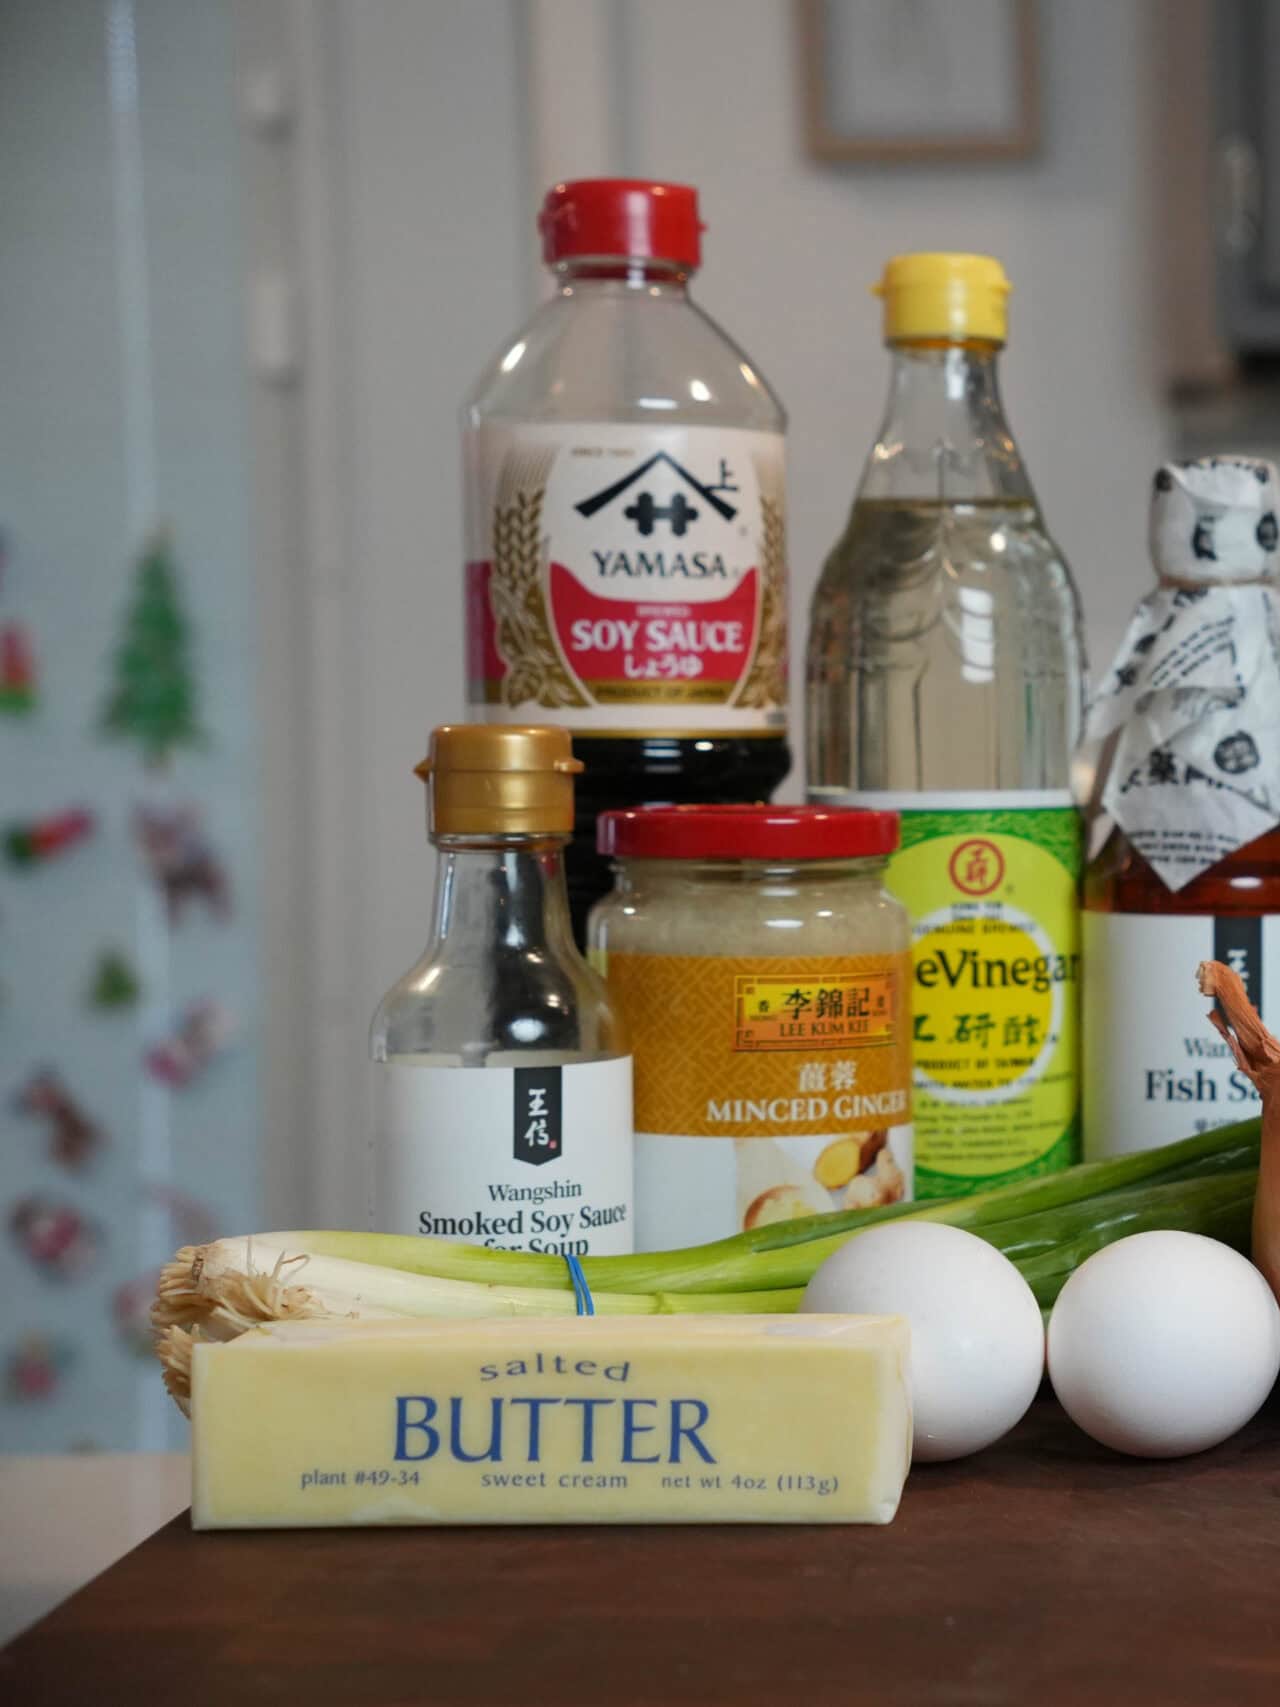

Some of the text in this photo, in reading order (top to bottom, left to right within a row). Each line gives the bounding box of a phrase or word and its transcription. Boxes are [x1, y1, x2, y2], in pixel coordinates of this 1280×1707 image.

[593, 551, 727, 579] YAMASA
[571, 619, 744, 652] SOY SAUCE
[914, 949, 1081, 993] eVinegar
[781, 988, 869, 1020] 李錦記
[780, 1023, 806, 1037] LEE
[811, 1022, 844, 1035] KUM
[1145, 1069, 1216, 1101] Fish
[706, 1098, 829, 1122] MINCED
[488, 1180, 582, 1205] Wangshin
[419, 1204, 626, 1237] Smoked Soy Sauce
[480, 1353, 630, 1382] salted
[393, 1396, 717, 1464] BUTTER
[301, 1469, 420, 1489] plant #49-34
[481, 1473, 628, 1488] sweet cream
[661, 1474, 839, 1496] net wt 4oz (113g)
